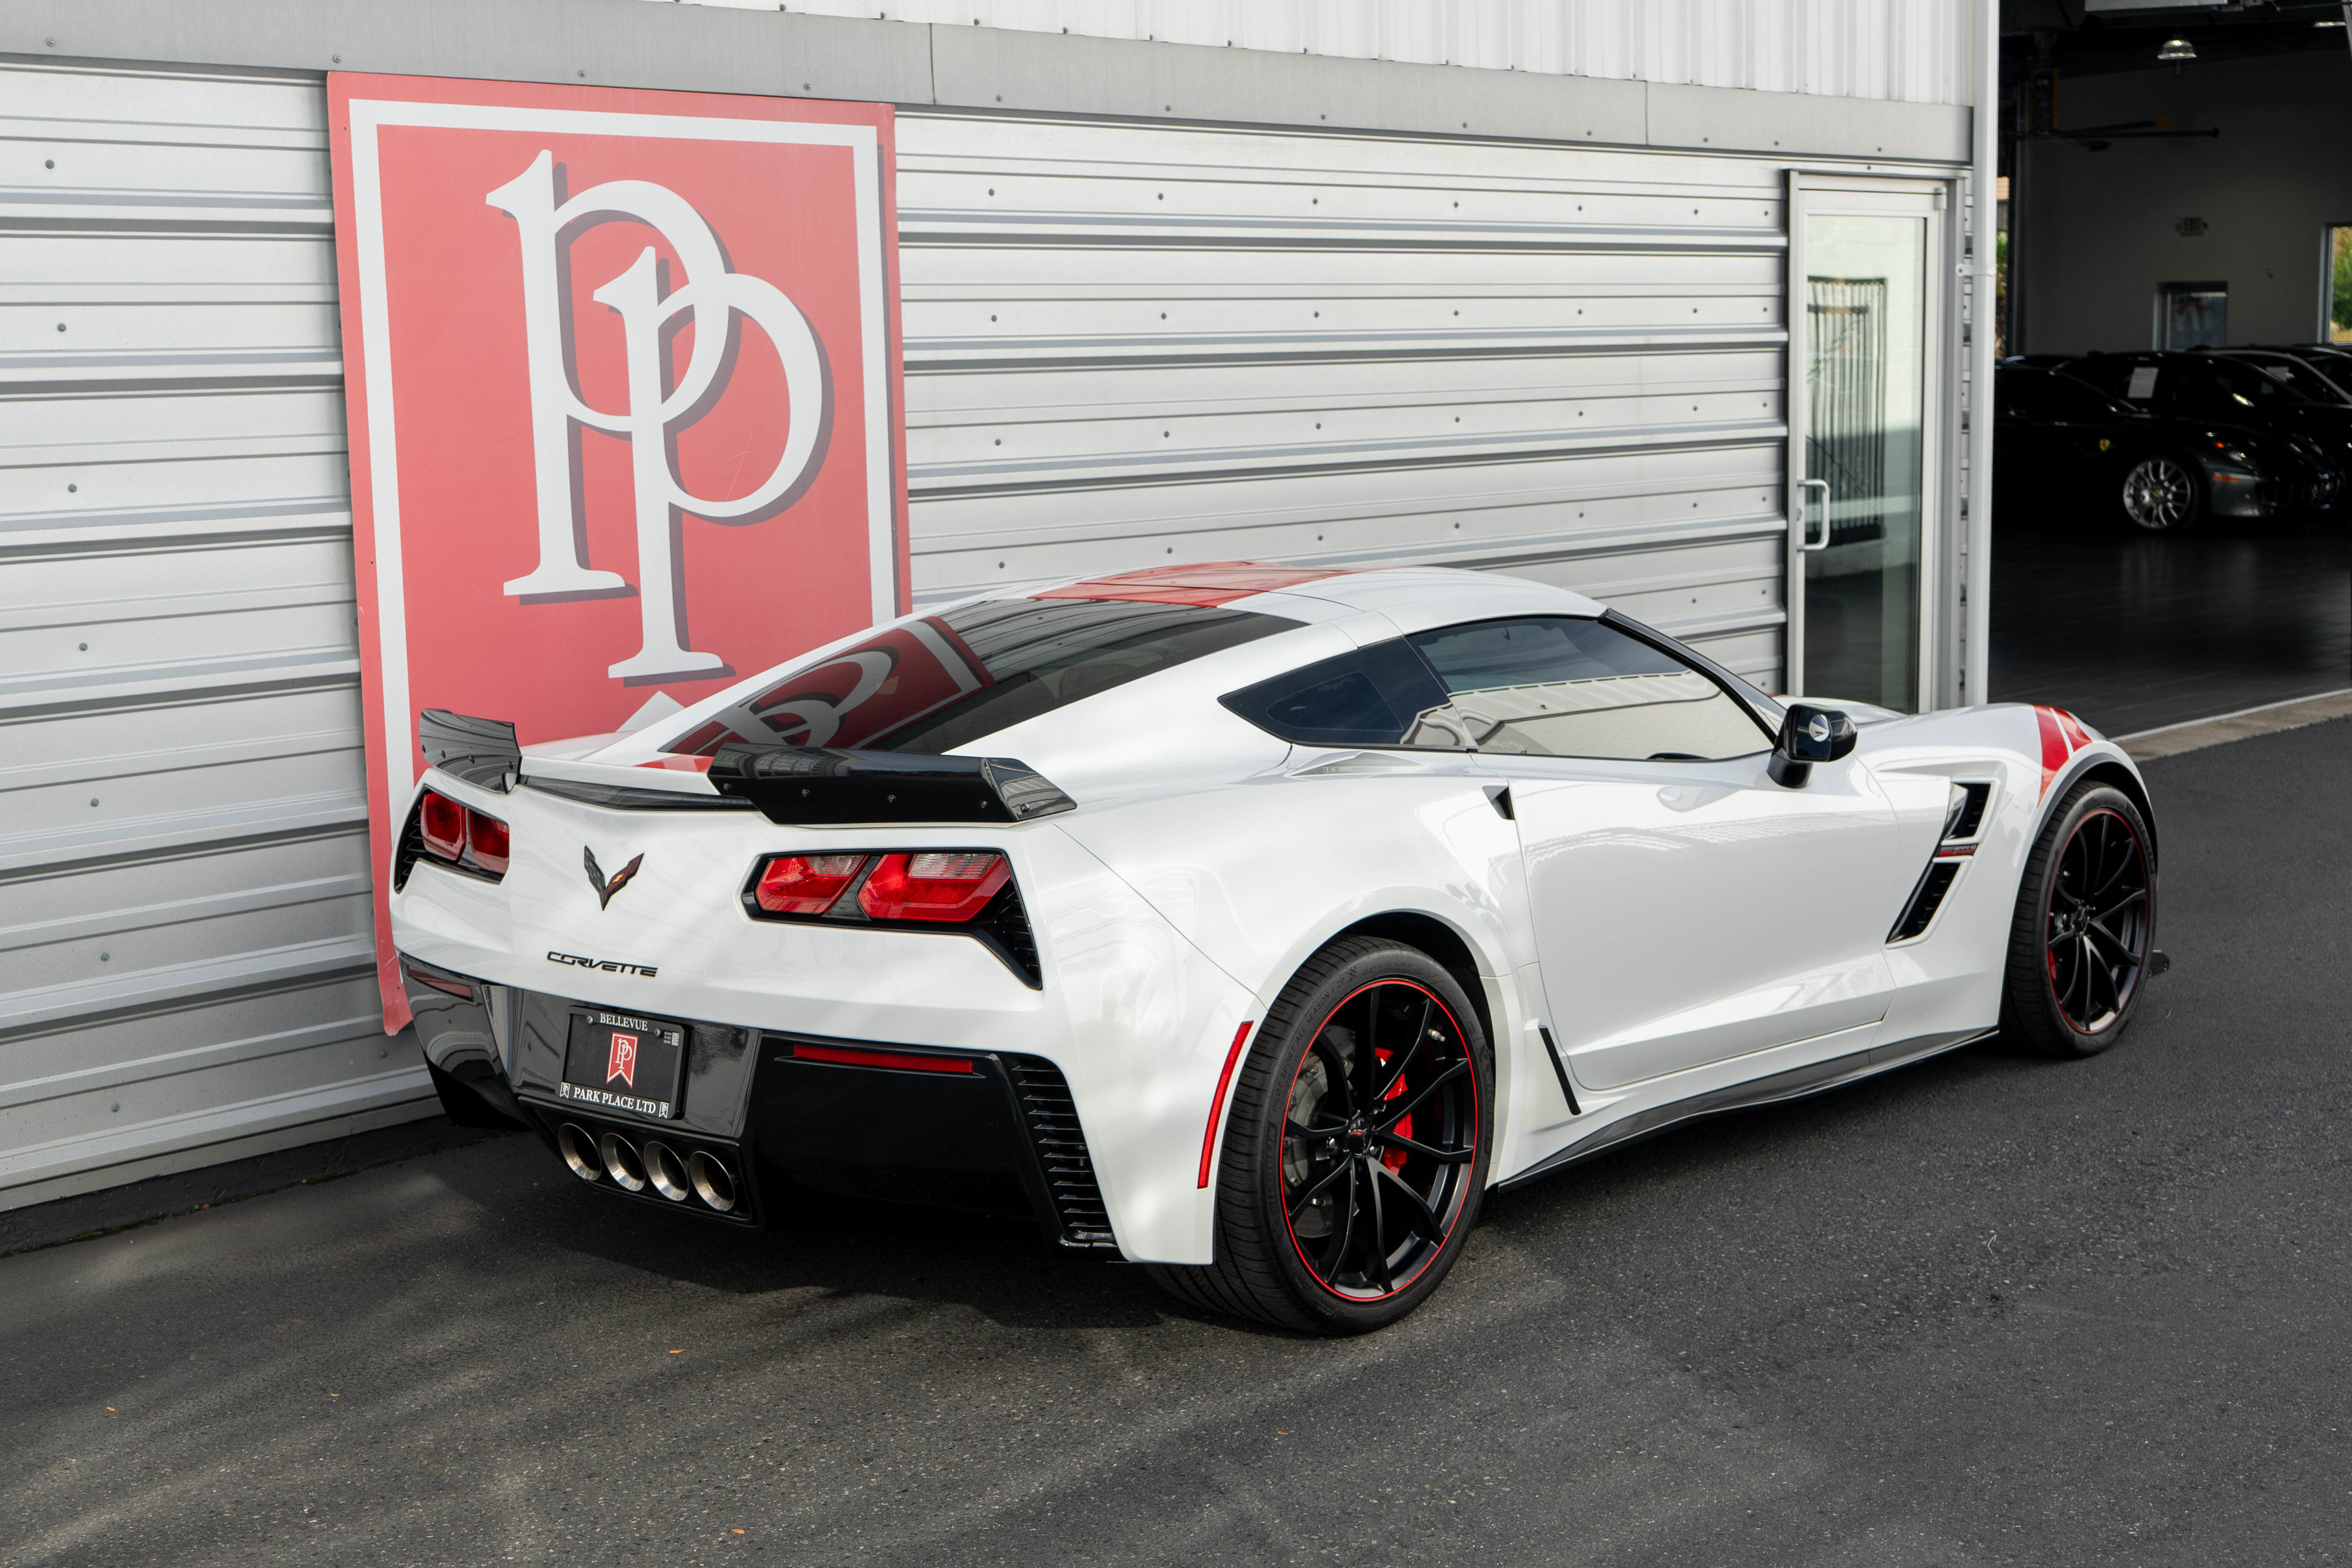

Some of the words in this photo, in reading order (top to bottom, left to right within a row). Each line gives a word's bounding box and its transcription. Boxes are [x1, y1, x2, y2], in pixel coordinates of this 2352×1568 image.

[547, 951, 658, 977] CORVETTE
[600, 1013, 648, 1031] BELLEVUE
[1272, 1082, 1283, 1112] PILOT
[1281, 1046, 1296, 1079] SPORT
[1296, 1026, 1306, 1044] ALL
[1306, 993, 1330, 1025] SEASON
[573, 1087, 600, 1103] PARK
[602, 1092, 634, 1111] PLACE
[635, 1099, 656, 1114] LTD
